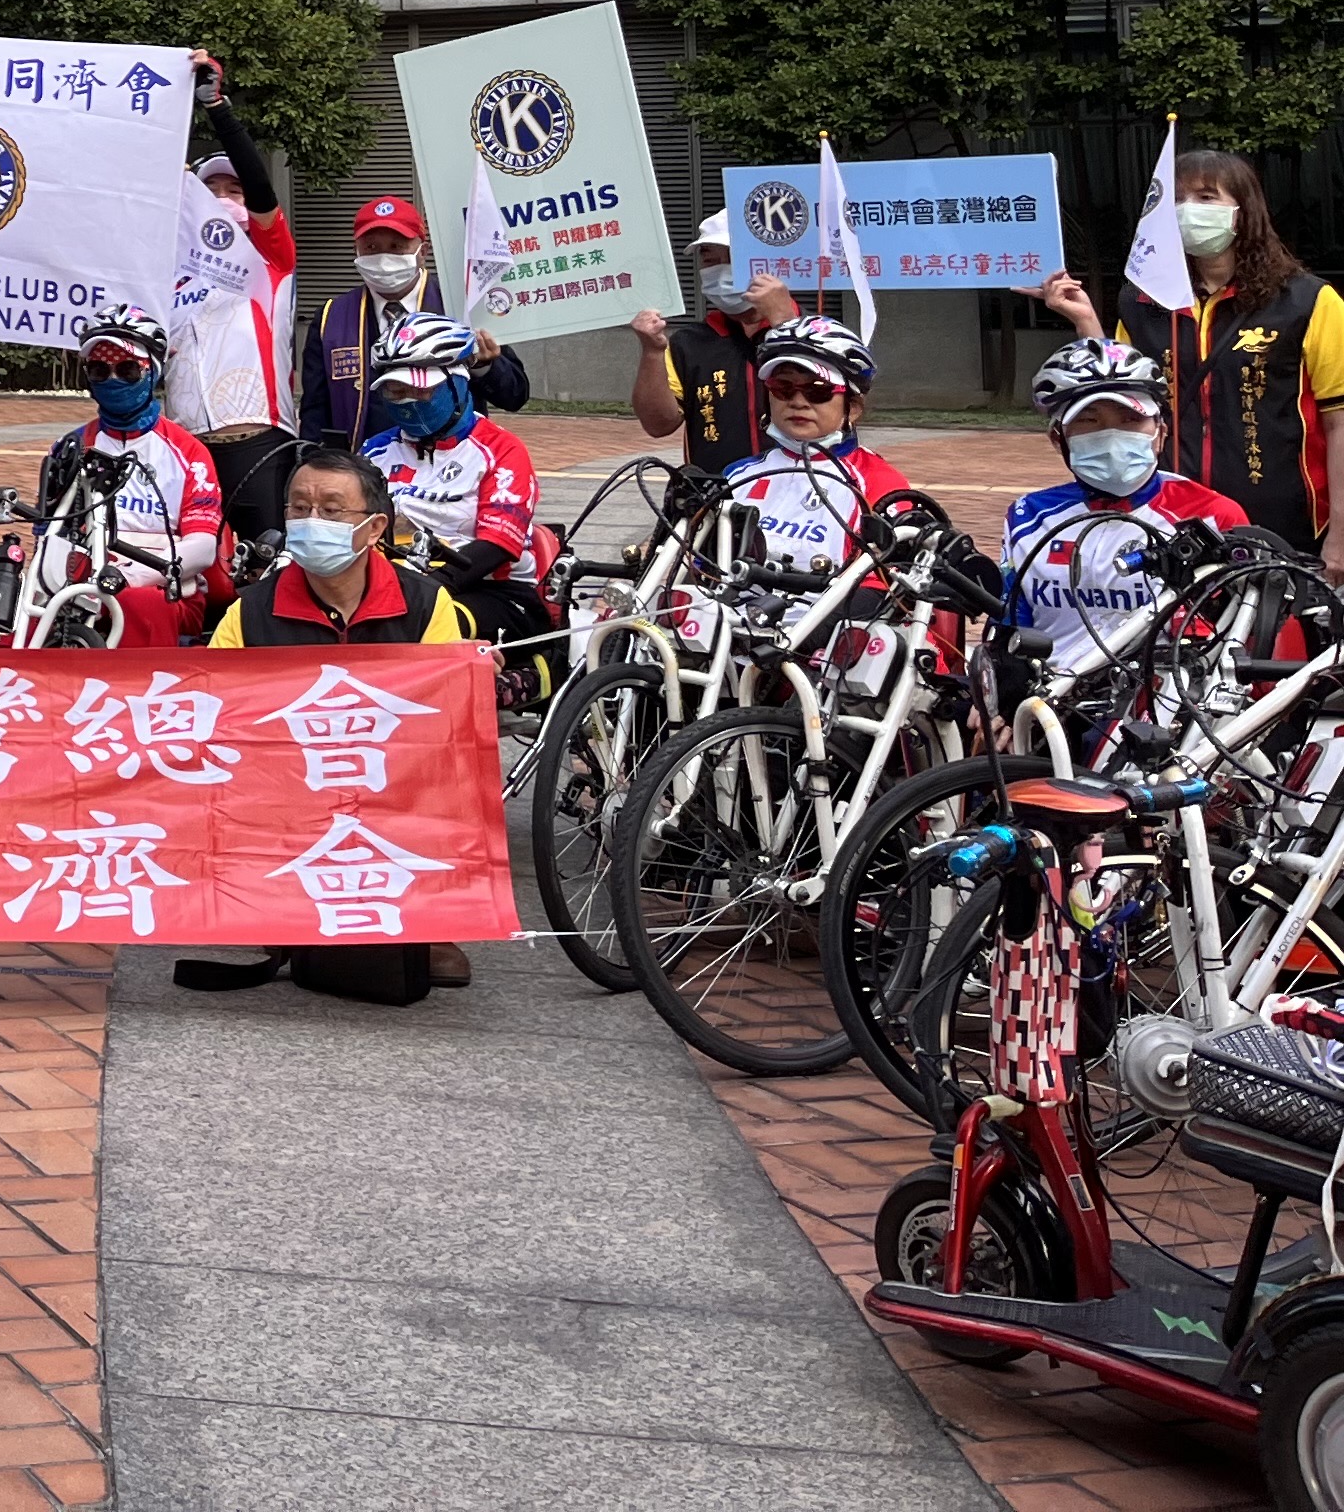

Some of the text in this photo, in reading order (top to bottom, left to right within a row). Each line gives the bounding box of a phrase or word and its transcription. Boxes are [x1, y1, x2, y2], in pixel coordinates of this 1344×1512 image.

[483, 79, 549, 111] KIWANIS
[480, 109, 565, 167] INTERNATIONAL
[498, 93, 551, 154] K
[463, 180, 619, 228] wanis
[754, 188, 794, 204] KIWANIS
[815, 194, 1038, 227] 際同濟會臺灣總會
[507, 236, 541, 256] 領航
[900, 251, 1043, 277] 點亮兒童未來
[68, 284, 106, 309] OF
[515, 271, 633, 307] 東方國際同濟會
[758, 515, 828, 544] anis
